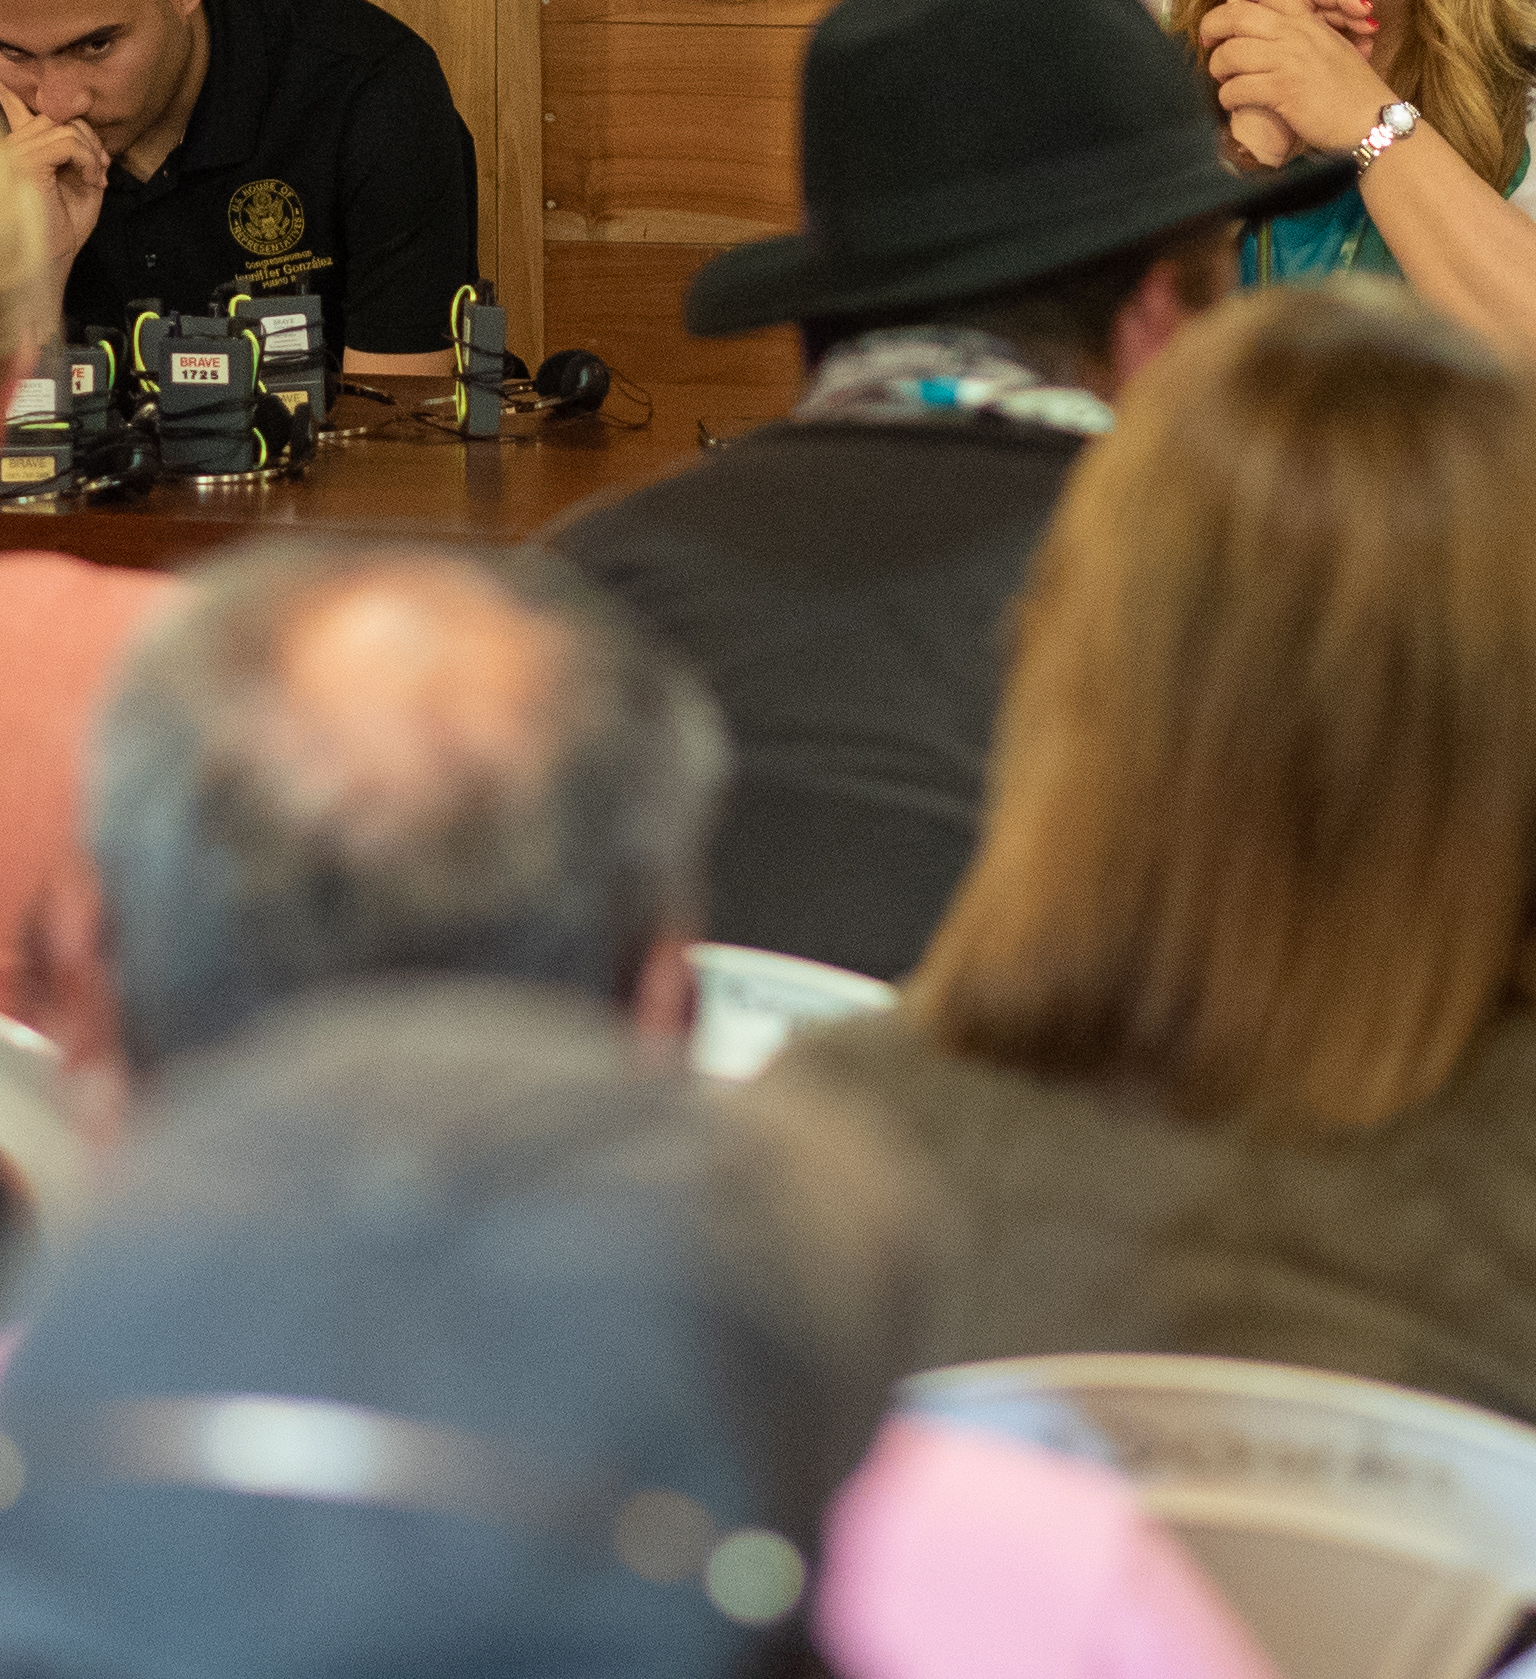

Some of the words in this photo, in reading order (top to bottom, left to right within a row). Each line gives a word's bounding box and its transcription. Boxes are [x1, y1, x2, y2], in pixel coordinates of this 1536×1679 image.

[241, 182, 276, 196] HOUSE
[280, 185, 295, 199] OF
[282, 255, 334, 275] González
[180, 356, 221, 368] BRAVE
[182, 369, 219, 380] 1725
